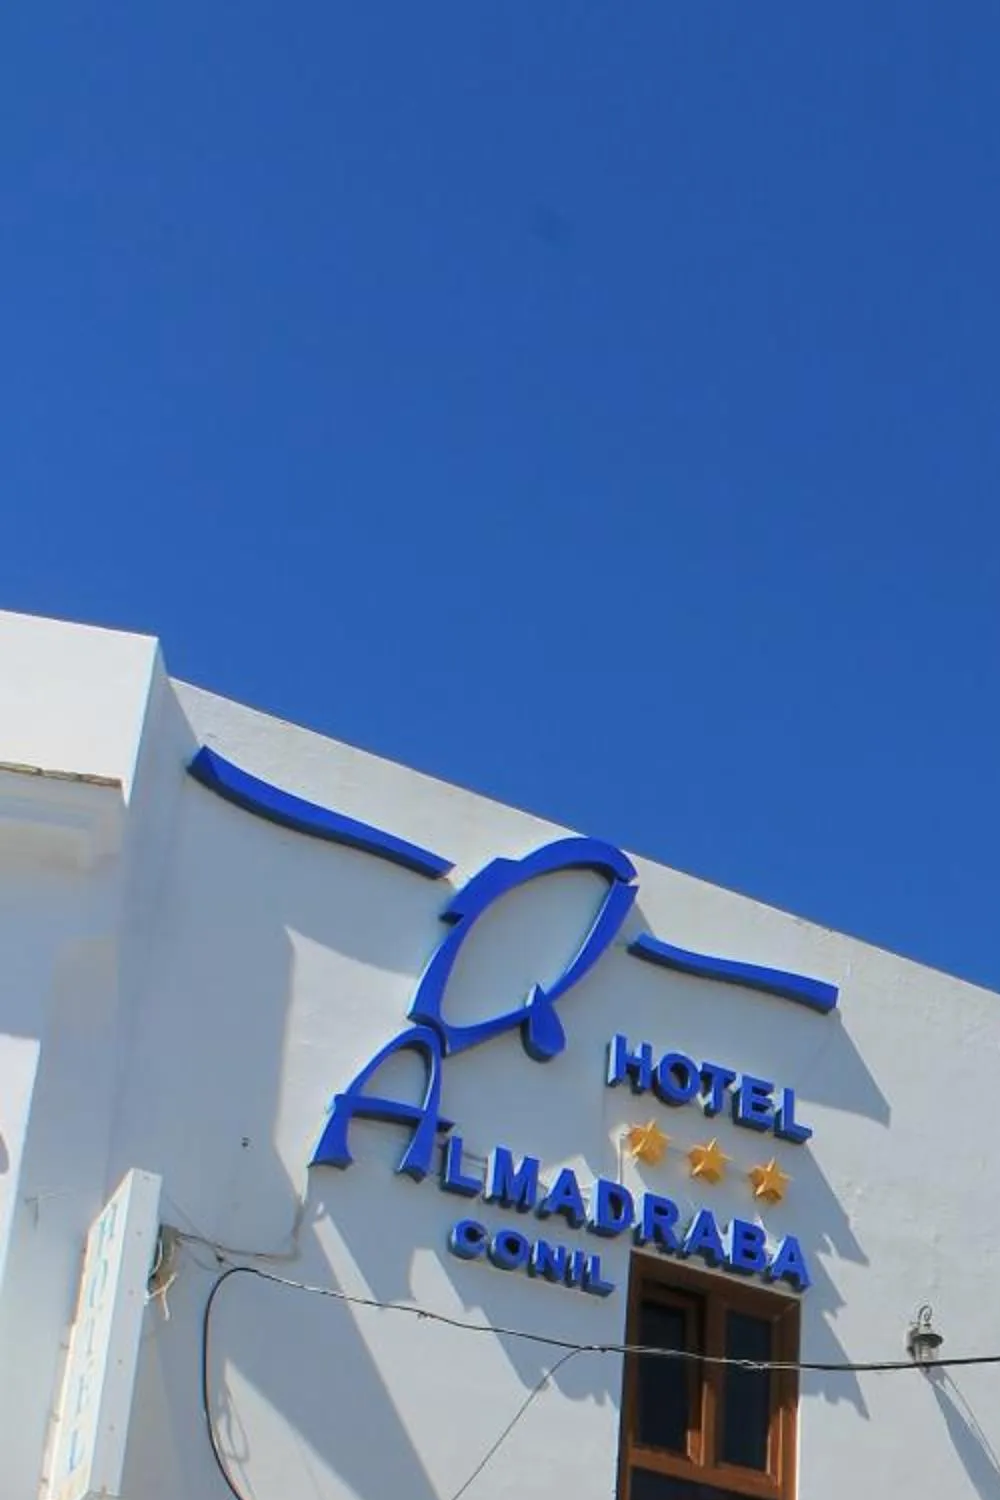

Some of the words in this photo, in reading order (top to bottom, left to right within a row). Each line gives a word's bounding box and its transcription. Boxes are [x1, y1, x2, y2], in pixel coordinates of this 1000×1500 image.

[606, 1033, 812, 1144] HOTEL
[307, 1022, 812, 1293] ALMADRABA
[447, 1218, 616, 1297] CONIL
